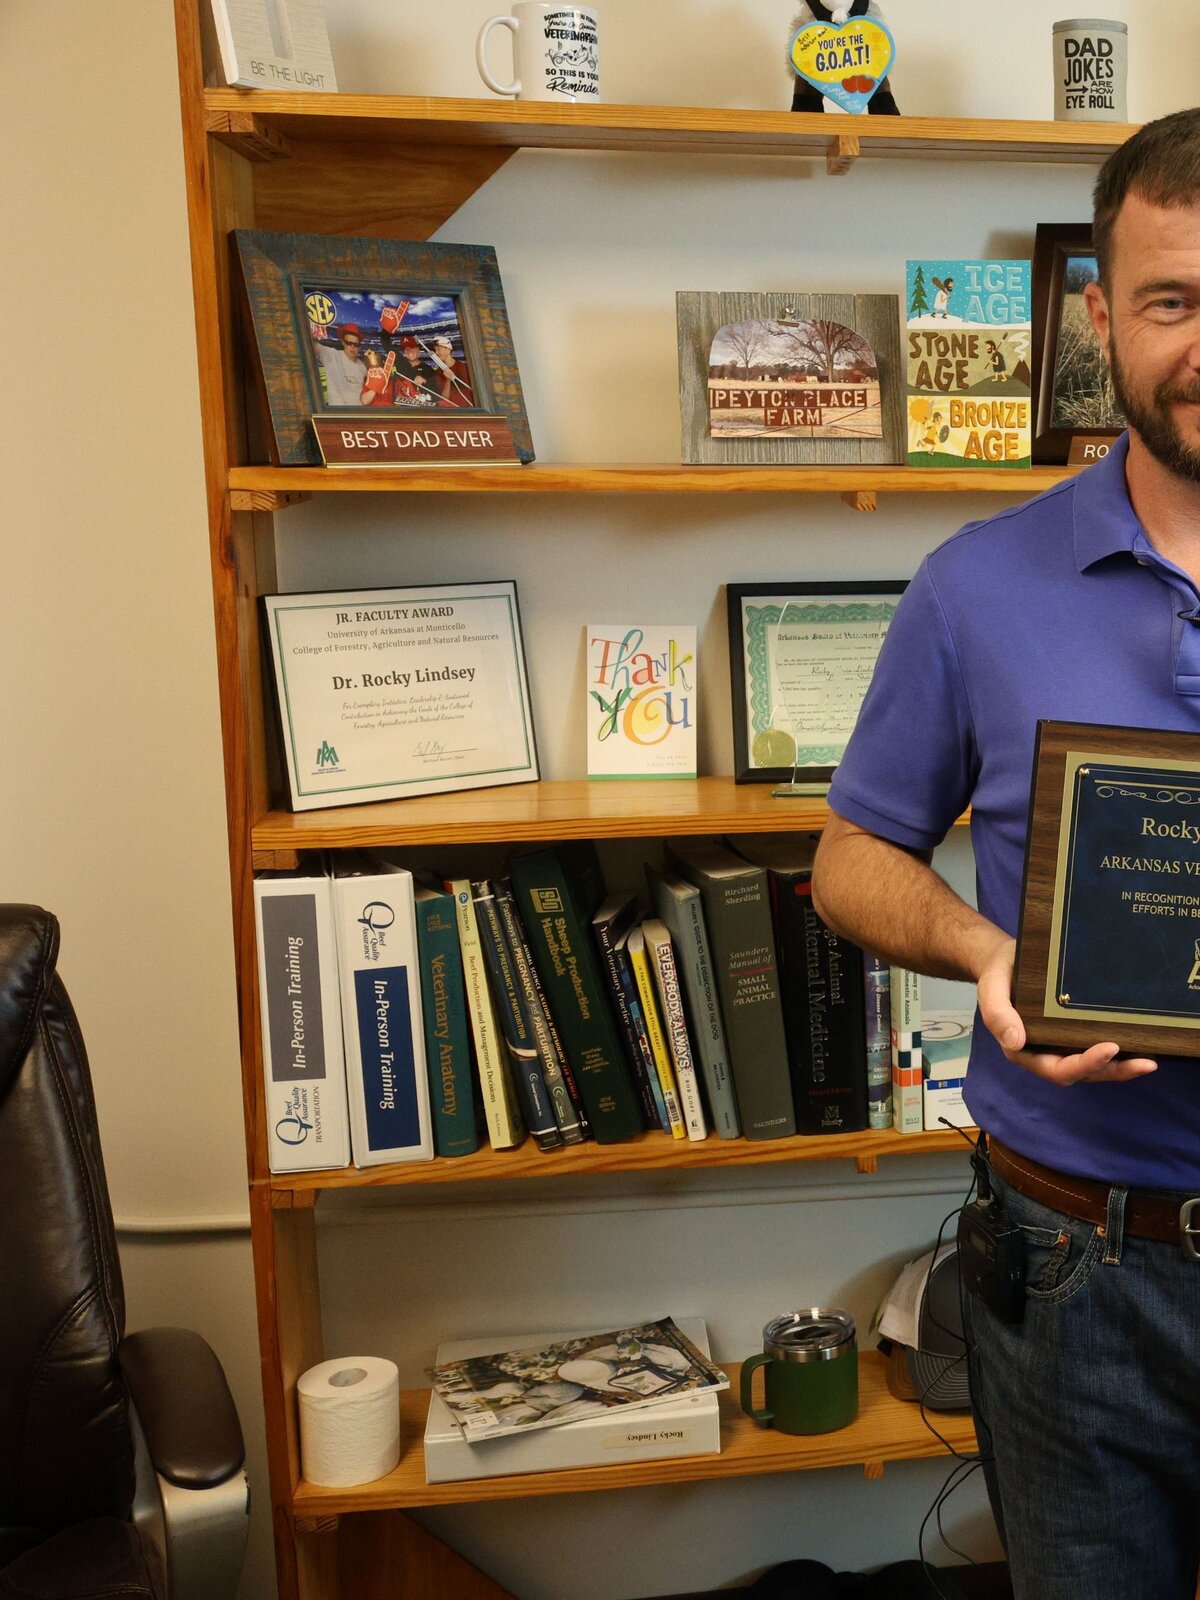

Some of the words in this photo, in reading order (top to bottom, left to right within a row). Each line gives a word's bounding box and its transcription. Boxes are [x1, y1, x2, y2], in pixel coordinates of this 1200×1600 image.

[818, 37, 846, 50] YOU'RE
[849, 34, 863, 45] THE
[1064, 38, 1113, 58] DAD
[251, 60, 265, 77] BE
[269, 64, 291, 82] THE
[294, 67, 325, 88] LIGHT
[559, 69, 576, 77] THIS
[579, 71, 585, 79] IS
[1064, 58, 1114, 87] JOKES
[1090, 81, 1113, 89] ARE
[1066, 96, 1085, 109] EYE
[1088, 95, 1115, 109] ROLL
[1090, 87, 1114, 95] HOW
[965, 264, 1024, 292] ICE
[306, 293, 335, 325] SEC
[963, 293, 1026, 325] AGE
[908, 332, 980, 360] STONE
[915, 358, 970, 392] AGE
[715, 389, 795, 408] PEYTON
[803, 390, 866, 407] PLACE
[767, 409, 820, 426] FARM
[949, 399, 1027, 429] BRONZE
[341, 431, 390, 448] BEST
[395, 431, 440, 448] DAD
[447, 430, 494, 448] EVER
[964, 429, 1020, 462] AGE
[336, 613, 353, 625] JR.
[355, 609, 408, 622] FACULTY
[412, 606, 454, 619] AWARD
[327, 630, 368, 639] University
[370, 628, 378, 636] of
[380, 626, 415, 635] Arkansas
[425, 622, 466, 632] Monticello
[293, 646, 322, 655] College
[334, 643, 371, 652] Forestry,
[372, 639, 416, 650] Agriculture
[418, 637, 431, 646] and
[432, 635, 461, 645] Natural
[462, 633, 499, 642] Resources
[332, 676, 357, 690] Dr.
[362, 671, 411, 688] Rocky
[415, 666, 476, 683] Lindsey
[1100, 855, 1180, 874] ARKANSAS
[725, 883, 759, 897] Birchard
[725, 893, 761, 905] Sherding
[1121, 891, 1131, 900] IN
[1134, 892, 1200, 906] RECOGNITION
[462, 904, 470, 931] Pearson
[502, 903, 516, 939] Pathways
[1132, 904, 1175, 916] EFFORTS
[1178, 907, 1188, 917] IN
[378, 931, 386, 947] Beef
[487, 909, 499, 943] PATHWAYS
[693, 925, 702, 945] GUIDE
[362, 928, 370, 960] Assurance
[369, 937, 379, 962] Quality
[496, 944, 503, 953] TO
[511, 937, 518, 946] to
[541, 917, 566, 976] Handbook
[697, 945, 703, 954] TO
[730, 946, 769, 960] Saunders
[804, 906, 826, 987] Internal
[284, 937, 304, 996] Training
[469, 955, 478, 971] Beef
[499, 953, 514, 991] PREGNANCY
[514, 947, 536, 1002] PREGNANCY
[554, 917, 571, 955] Sheep
[566, 956, 590, 1020] Production
[729, 957, 761, 970] Manual
[762, 954, 771, 964] of
[600, 926, 610, 947] Your
[606, 948, 621, 991] Veterinary
[617, 992, 630, 1025] Practice
[701, 965, 711, 1002] DISSECTION
[738, 974, 767, 986] SMALL
[828, 950, 845, 1006] Animal
[431, 953, 449, 1038] Veterinary
[471, 971, 482, 1012] Production
[643, 983, 652, 1016] COMMISSION
[733, 991, 776, 1006] PRACTICE
[736, 983, 771, 996] ANIMAL
[374, 980, 390, 1048] In-Person
[523, 944, 533, 966] ANIMAL
[530, 966, 541, 990] SCIENCE
[550, 1026, 566, 1063] PHYSIOLOGY
[529, 1002, 540, 1016] and
[708, 1003, 714, 1013] OF
[477, 1012, 485, 1025] and
[511, 998, 527, 1040] PARTURITION
[291, 1000, 306, 1069] In-Person
[672, 1020, 690, 1070] ALWAYS
[711, 1024, 719, 1040] DOG
[808, 991, 828, 1084] Medicine
[480, 1024, 491, 1069] Management
[533, 1016, 557, 1077] PARTURITION
[379, 1052, 395, 1110] Training
[439, 1043, 456, 1116] Anatomy
[486, 1071, 496, 1103] Decisions
[292, 1086, 300, 1109] Quality
[313, 1086, 323, 1144] TRANSPORTATION
[627, 1433, 657, 1441] Lindsey
[660, 1431, 683, 1439] Rocky
